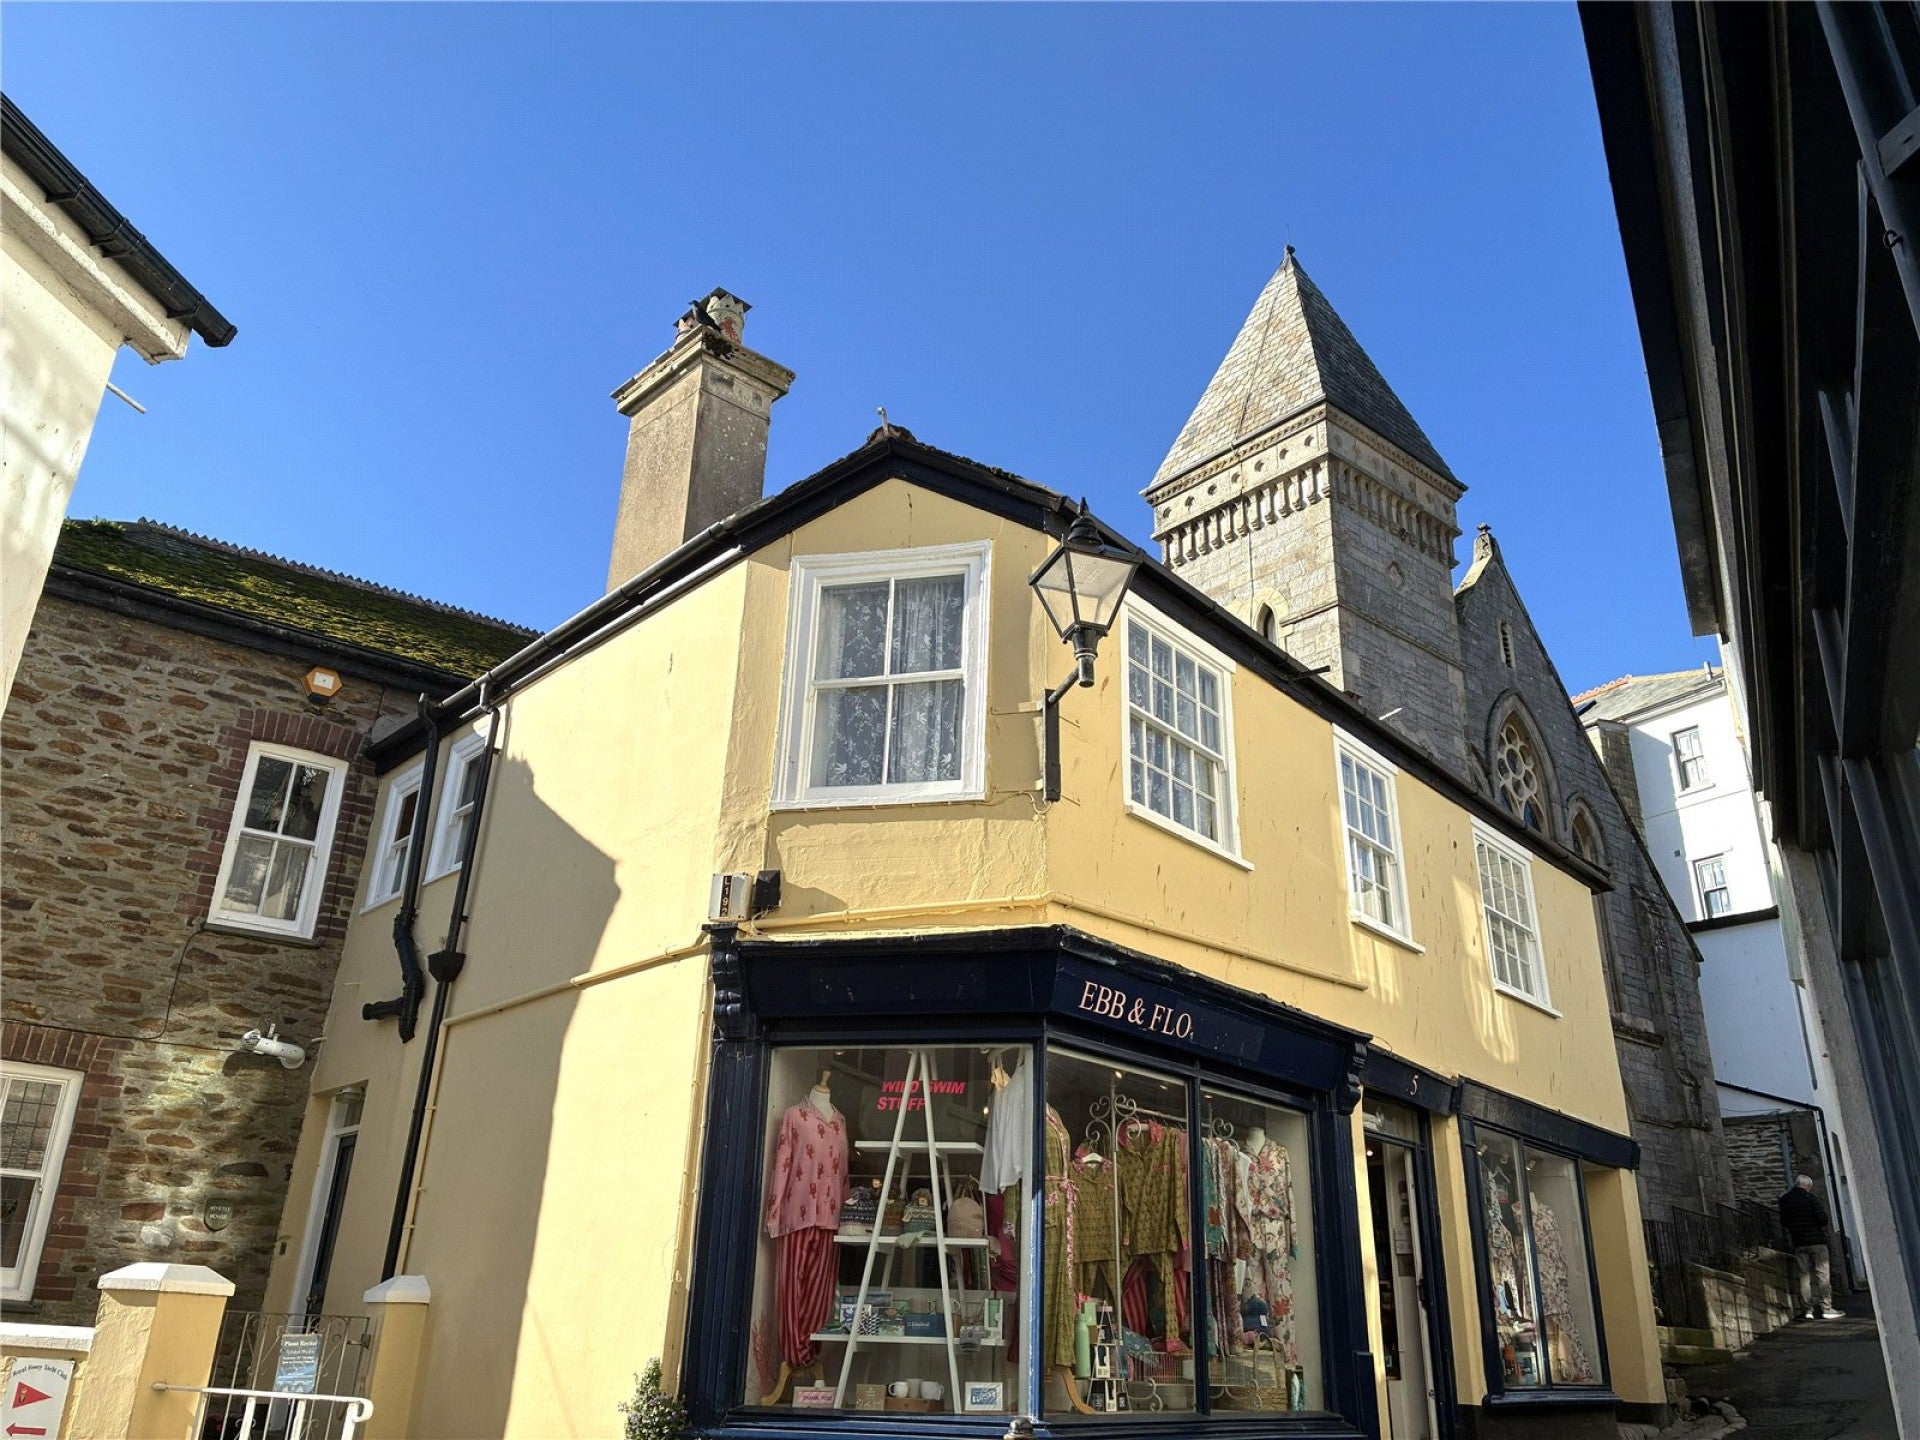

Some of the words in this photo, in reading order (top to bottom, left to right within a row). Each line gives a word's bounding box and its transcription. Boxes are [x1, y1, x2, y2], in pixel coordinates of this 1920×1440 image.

[721, 876, 731, 917] L192
[1079, 981, 1127, 1020] EBB
[1127, 998, 1146, 1026] &
[1148, 1004, 1192, 1039] FLO
[1410, 1074, 1419, 1095] 5
